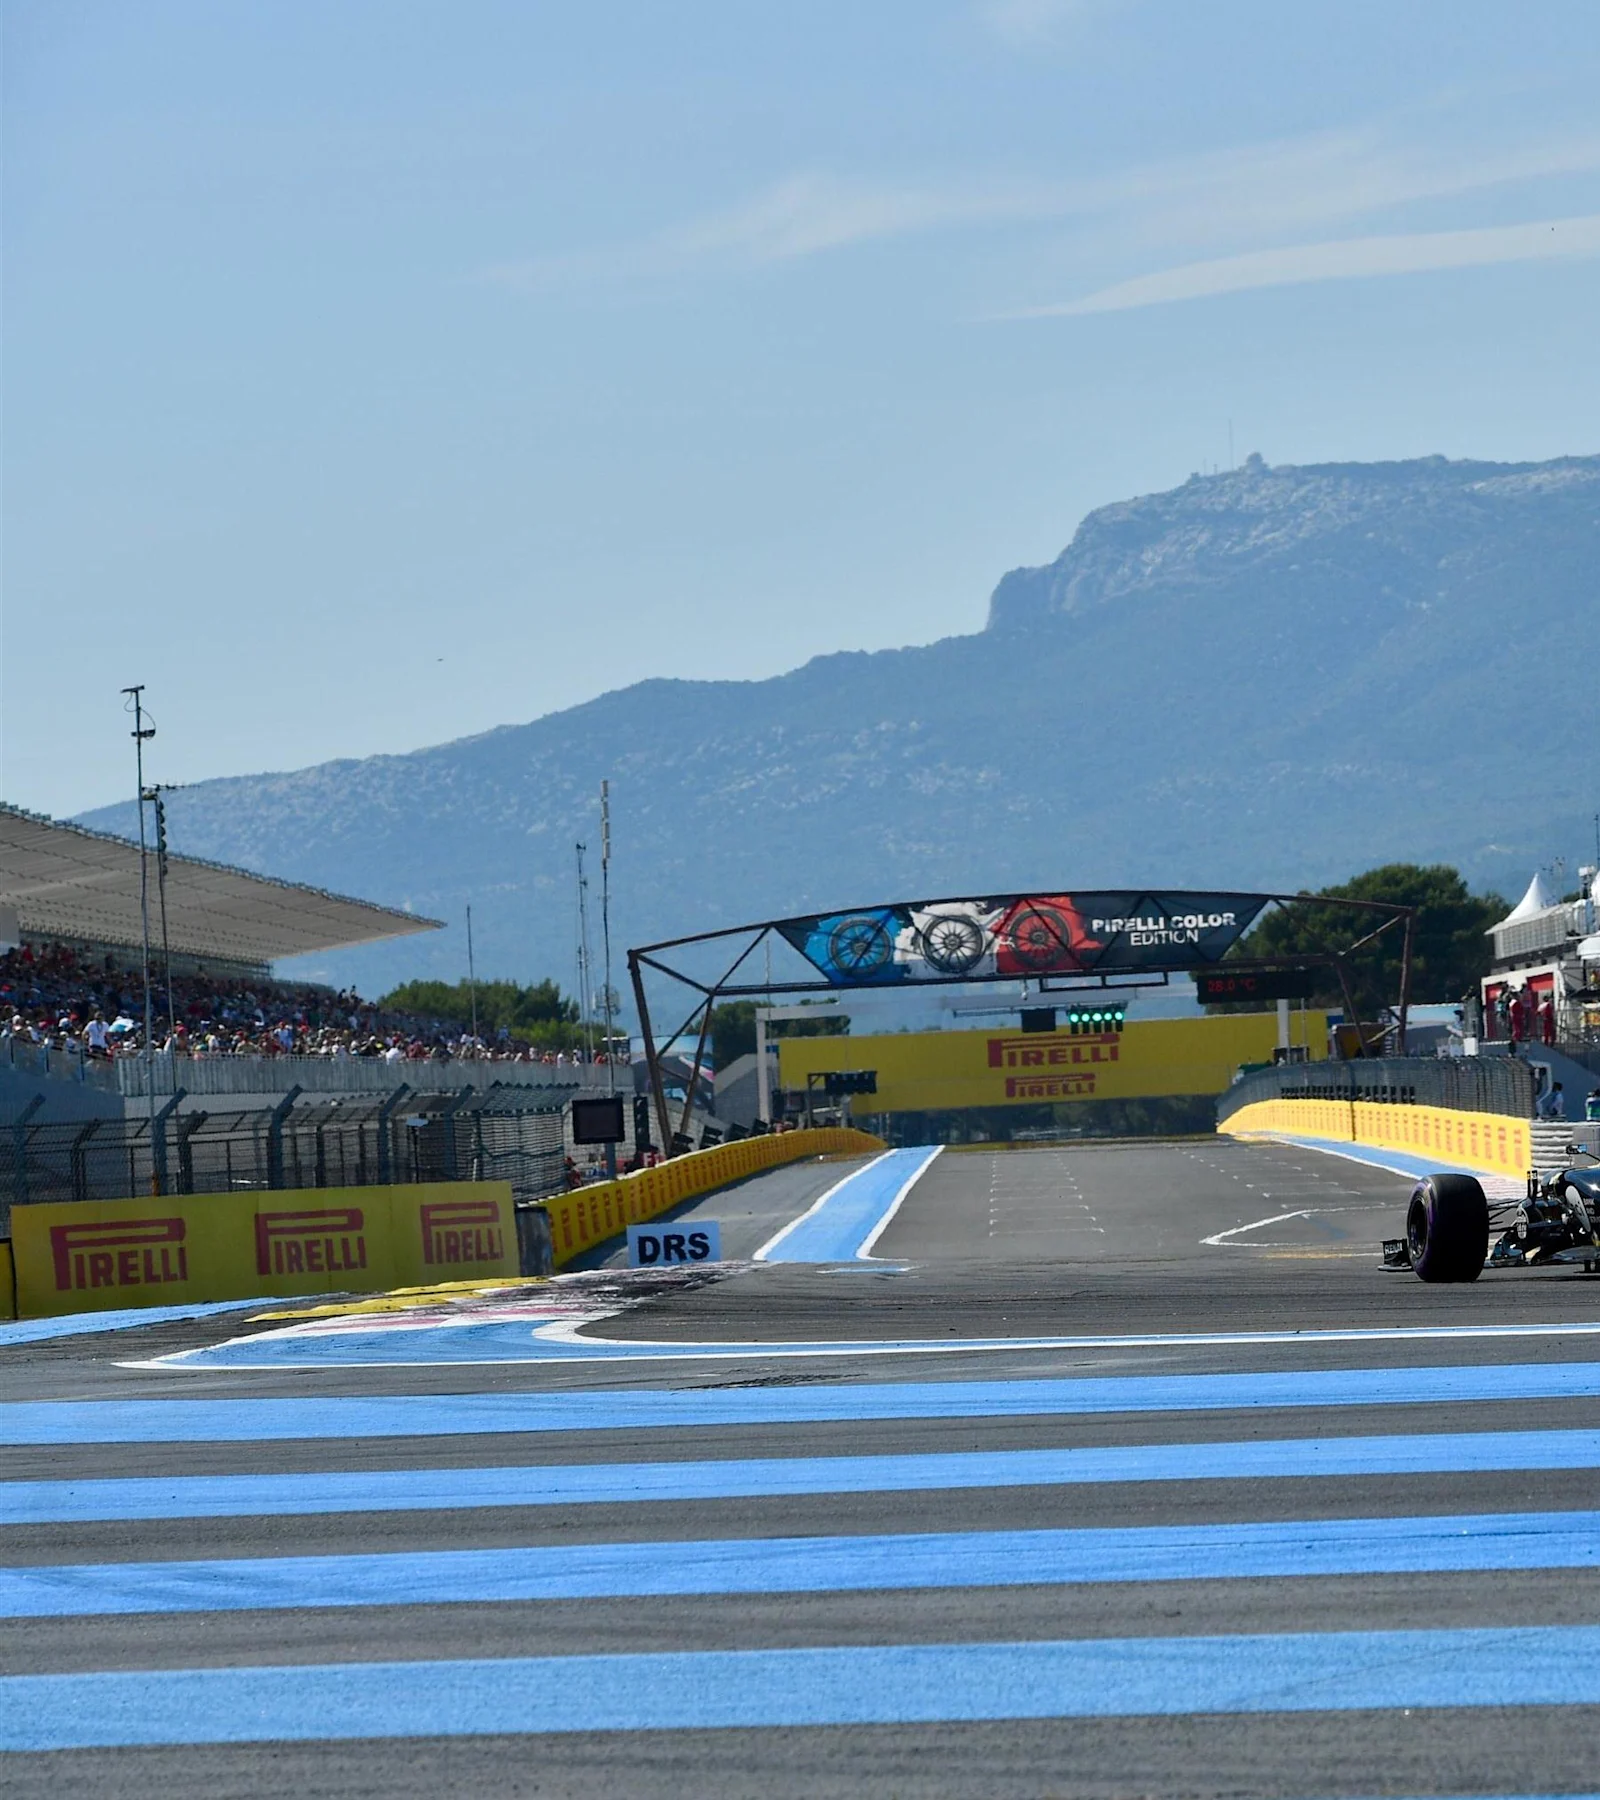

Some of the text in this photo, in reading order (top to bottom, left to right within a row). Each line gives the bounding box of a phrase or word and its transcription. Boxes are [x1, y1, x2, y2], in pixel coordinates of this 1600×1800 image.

[1091, 912, 1236, 933] PIRELLI COLOR
[1130, 929, 1199, 946] EDITION
[987, 1033, 1121, 1068] PIRELLI
[1005, 1073, 1096, 1098] PIRELLI
[254, 1208, 367, 1276] PIRELLI
[420, 1201, 505, 1265] PIRELLI
[637, 1231, 710, 1264] DRS
[50, 1217, 188, 1291] PIRELLI
